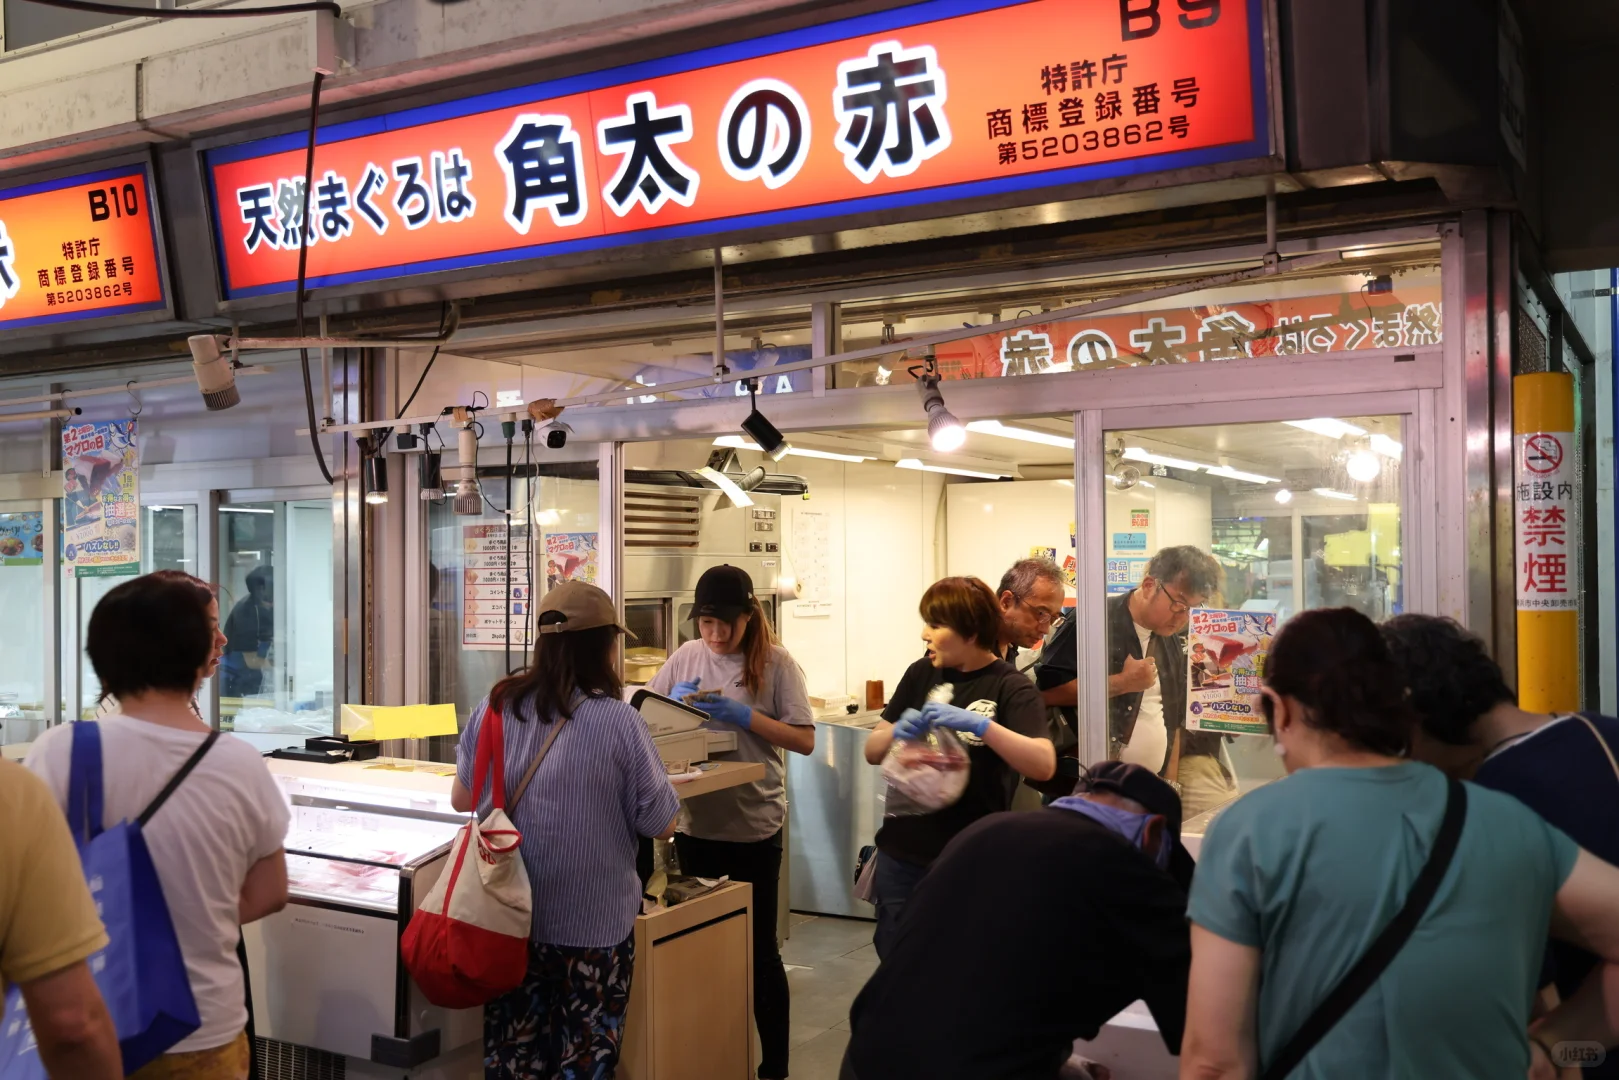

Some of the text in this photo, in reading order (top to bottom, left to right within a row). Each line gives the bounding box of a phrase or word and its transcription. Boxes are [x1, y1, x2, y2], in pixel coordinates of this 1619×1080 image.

[1119, 0, 1222, 42] B9
[1040, 54, 1128, 95] 特許庁
[986, 77, 1200, 139] 商標登録番号
[237, 46, 947, 254] 天然まぐろは 角太の赤
[998, 115, 1190, 165] 第5203862号
[88, 183, 139, 222] B10
[61, 237, 101, 261] 特許庁
[37, 256, 135, 288] 商標登録番号
[46, 282, 133, 306] 第5203862号
[65, 435, 104, 457] マグロの日
[1516, 481, 1573, 501] 施設内
[104, 502, 137, 519] 抽選会
[548, 541, 575, 553] マグロの日
[1522, 505, 1568, 594] 禁煙
[1107, 560, 1128, 571] 食品
[1193, 621, 1237, 635] マグロの日
[1235, 675, 1262, 689] 抽選
